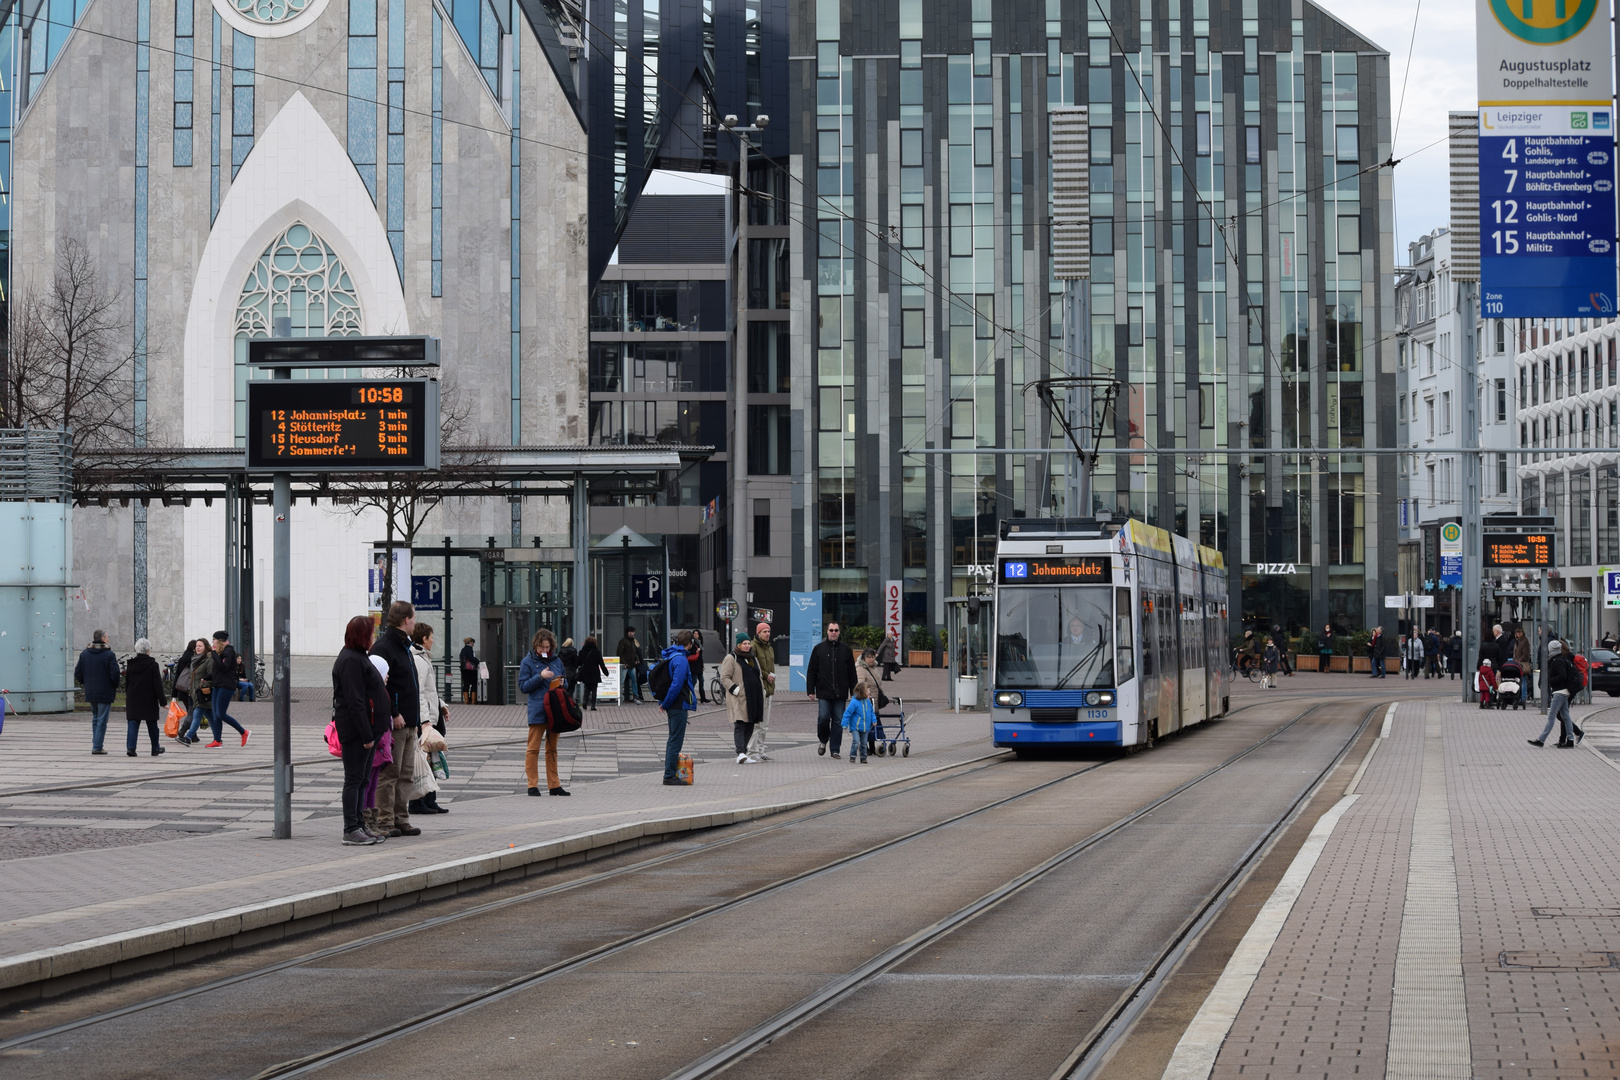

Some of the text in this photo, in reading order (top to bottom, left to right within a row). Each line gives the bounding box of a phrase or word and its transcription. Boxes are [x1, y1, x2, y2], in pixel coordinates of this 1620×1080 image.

[1499, 58, 1592, 75] Augustusplatz
[1503, 78, 1588, 90] Doppelhaltestelle
[1497, 112, 1542, 123] Leipziger
[1525, 137, 1583, 148] Hauptbahnhof
[1502, 138, 1518, 163] 4
[1525, 147, 1553, 156] Gohlis,
[1525, 158, 1566, 166] Landsberger
[1504, 169, 1518, 193] 7
[1525, 170, 1584, 181] Hauptbahnhof
[1525, 183, 1592, 193] Böhlitz-Ehrenberg
[1491, 200, 1518, 224] 12
[1526, 201, 1585, 212] Hauptbahnhof
[1526, 231, 1585, 241] Hauptbahnhof
[1491, 230, 1519, 254] 15
[1526, 243, 1553, 252] Miltitz
[1486, 302, 1503, 313] 110
[358, 387, 403, 403] 10:58
[271, 410, 286, 420] 12
[379, 409, 384, 419] 1
[387, 409, 408, 419] min
[278, 421, 408, 432] 4 Stötteritz 3 min
[271, 432, 408, 444] 15 Meusdorf 5 min
[278, 445, 285, 455] 7
[378, 444, 386, 452] 7
[387, 444, 408, 455] min
[967, 564, 995, 576] PAS
[1009, 562, 1101, 577] 12 Johannisplatz
[1256, 563, 1297, 575] PIZZA
[429, 581, 440, 600] P
[648, 579, 660, 599] P
[1087, 710, 1108, 719] 1130
